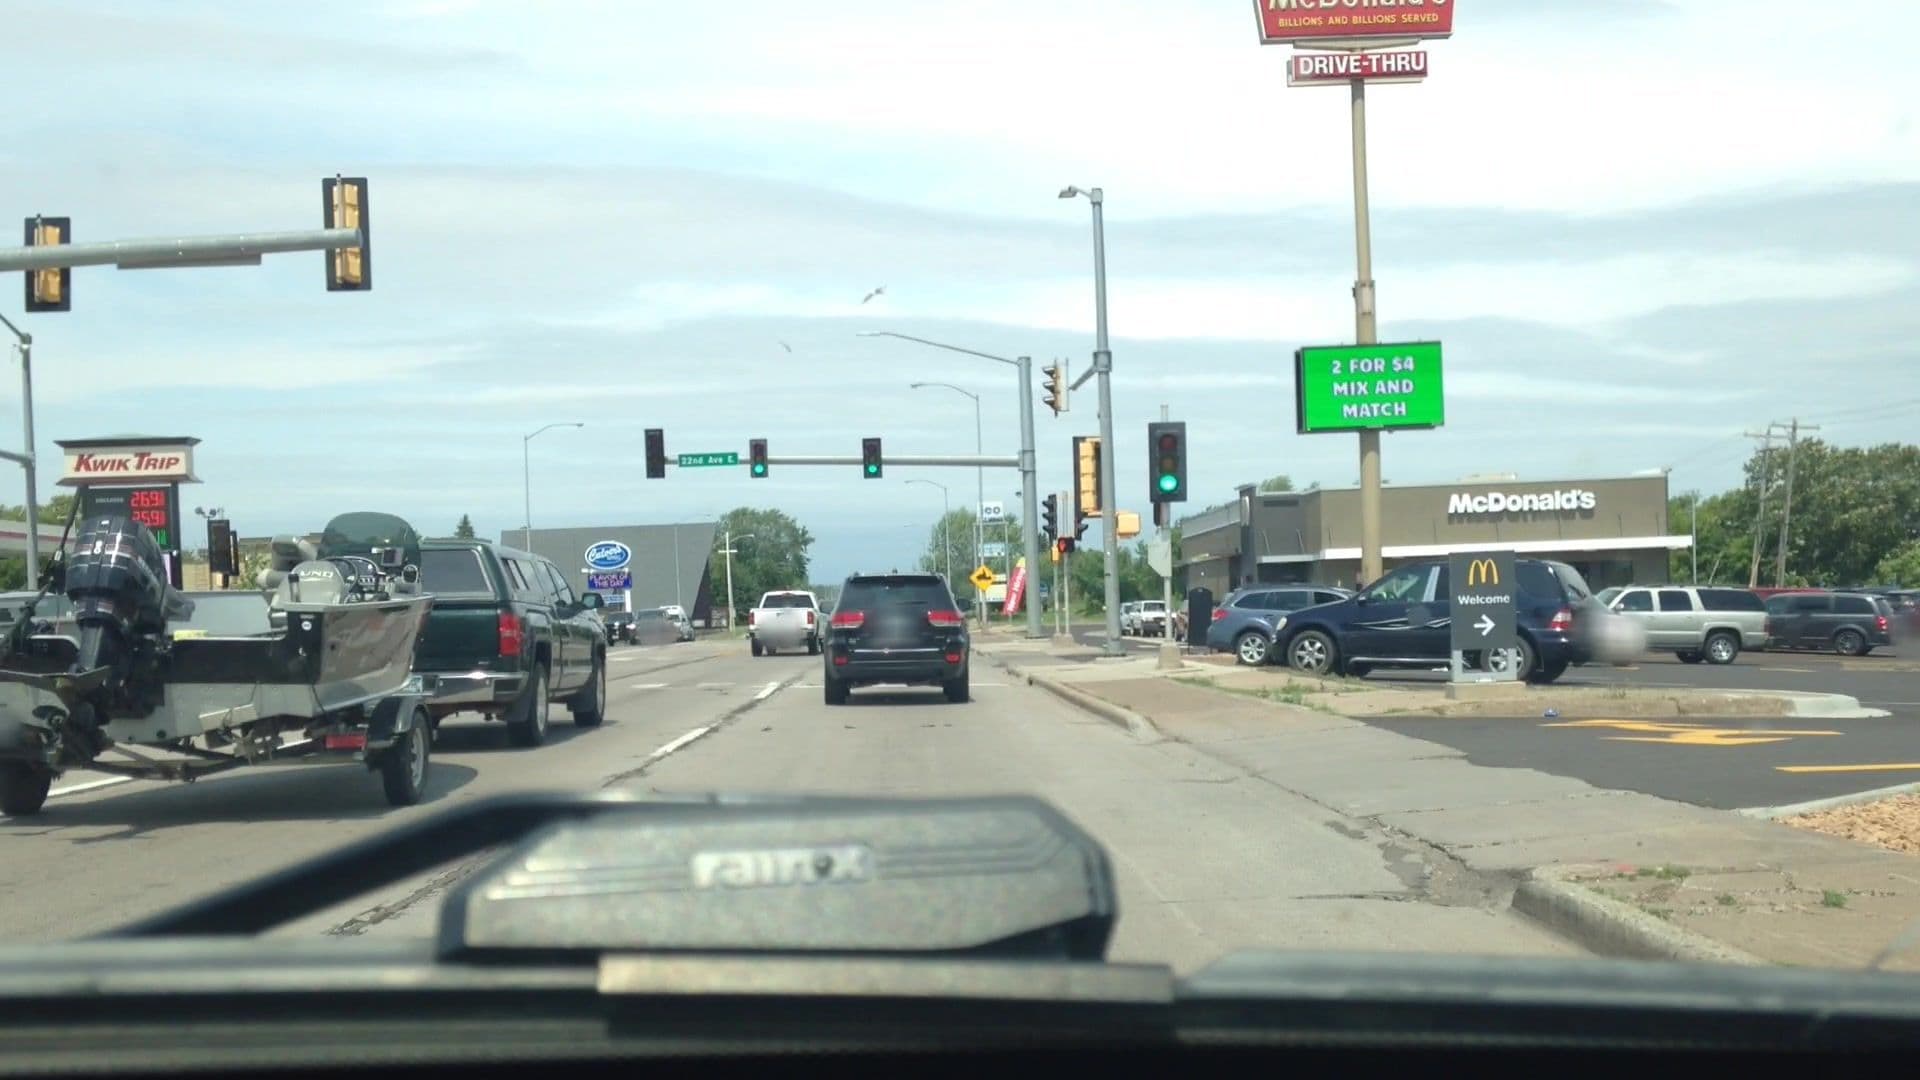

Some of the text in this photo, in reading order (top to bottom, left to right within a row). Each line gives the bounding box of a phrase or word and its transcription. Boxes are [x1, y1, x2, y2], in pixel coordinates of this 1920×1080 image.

[1279, 13, 1439, 27] BILLIONS AND BILLIONS SERVED
[1299, 52, 1425, 75] DRIVE-THRU
[1331, 356, 1415, 374] 2 FOR $4
[1333, 379, 1414, 396] MIX AND
[1343, 402, 1407, 418] MATCH
[681, 456, 704, 465] 22nd
[708, 455, 723, 464] Ave
[1448, 489, 1596, 514] McDonald's
[1458, 594, 1511, 605] Welcome
